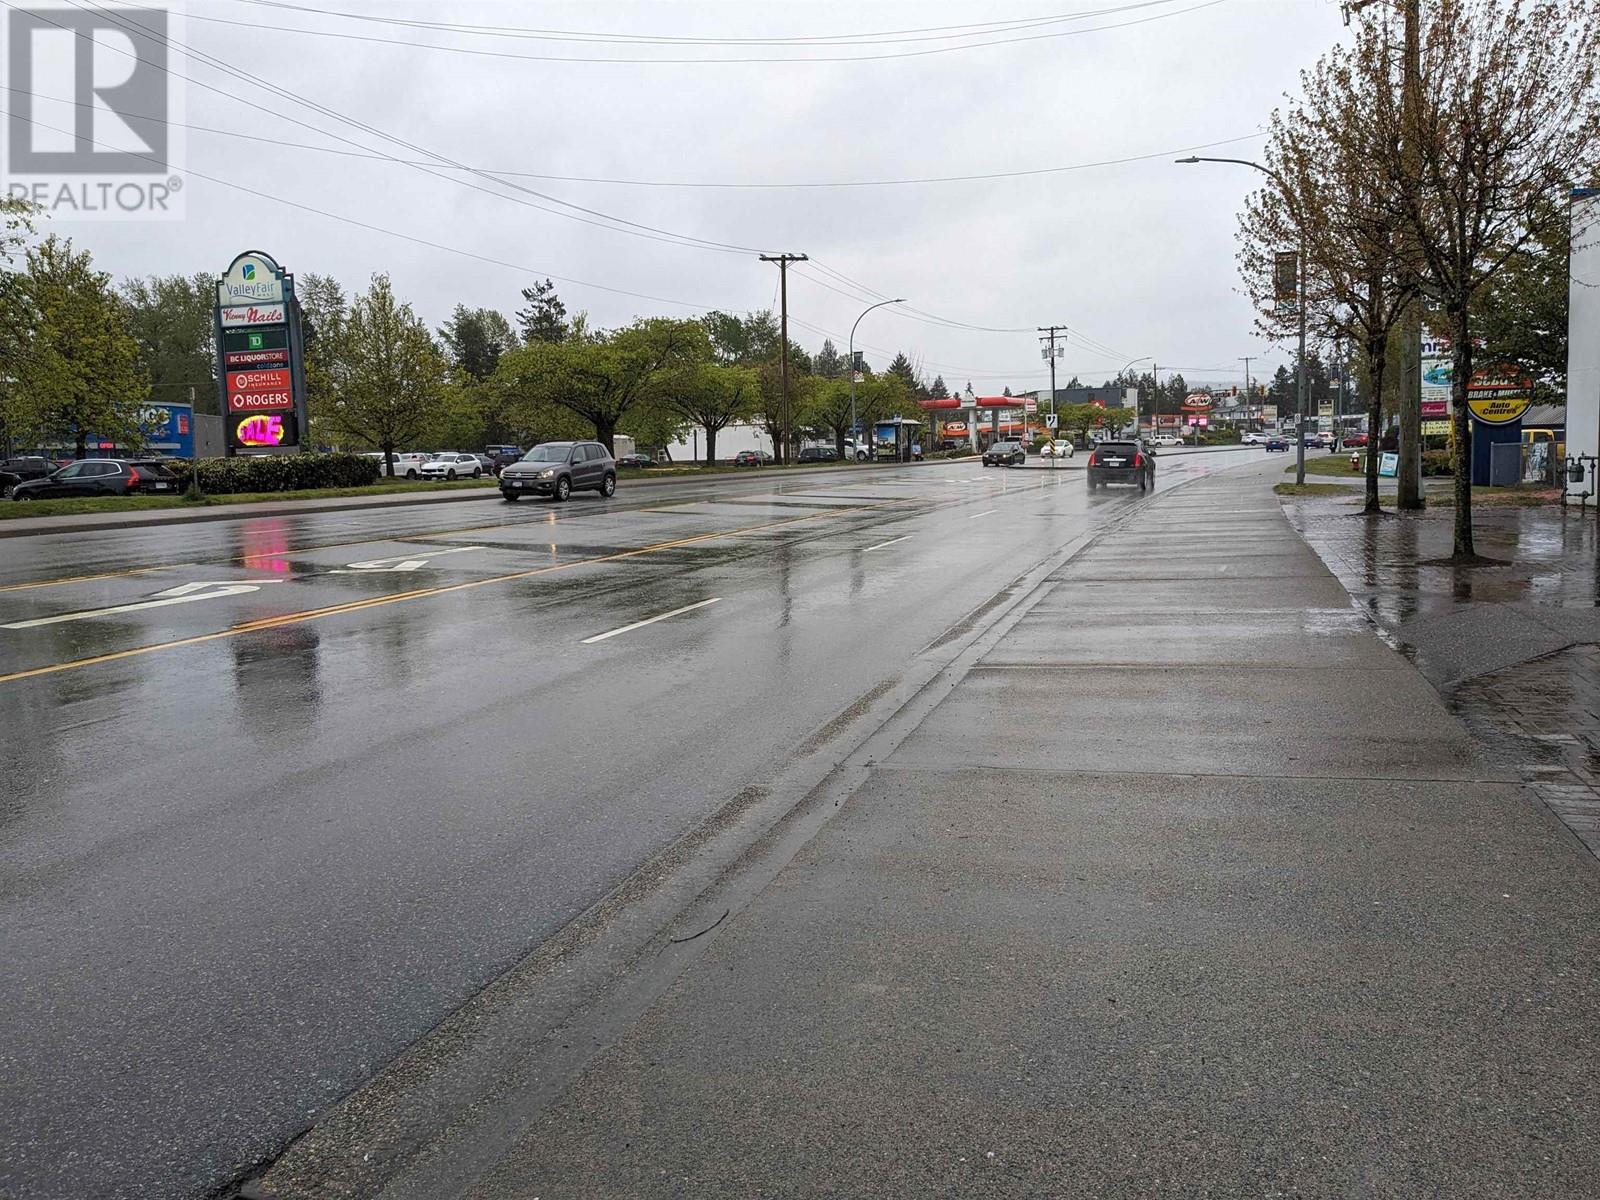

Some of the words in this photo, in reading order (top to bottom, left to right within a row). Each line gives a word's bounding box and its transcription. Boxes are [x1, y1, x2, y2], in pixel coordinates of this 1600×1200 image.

[226, 282, 274, 296] ValleyFair
[246, 306, 282, 322] Nails
[251, 337, 261, 346] TD
[248, 374, 281, 382] SCHILL
[246, 393, 288, 406] ROGERS
[1468, 390, 1493, 398] BRAKE
[240, 416, 282, 446] SALE
